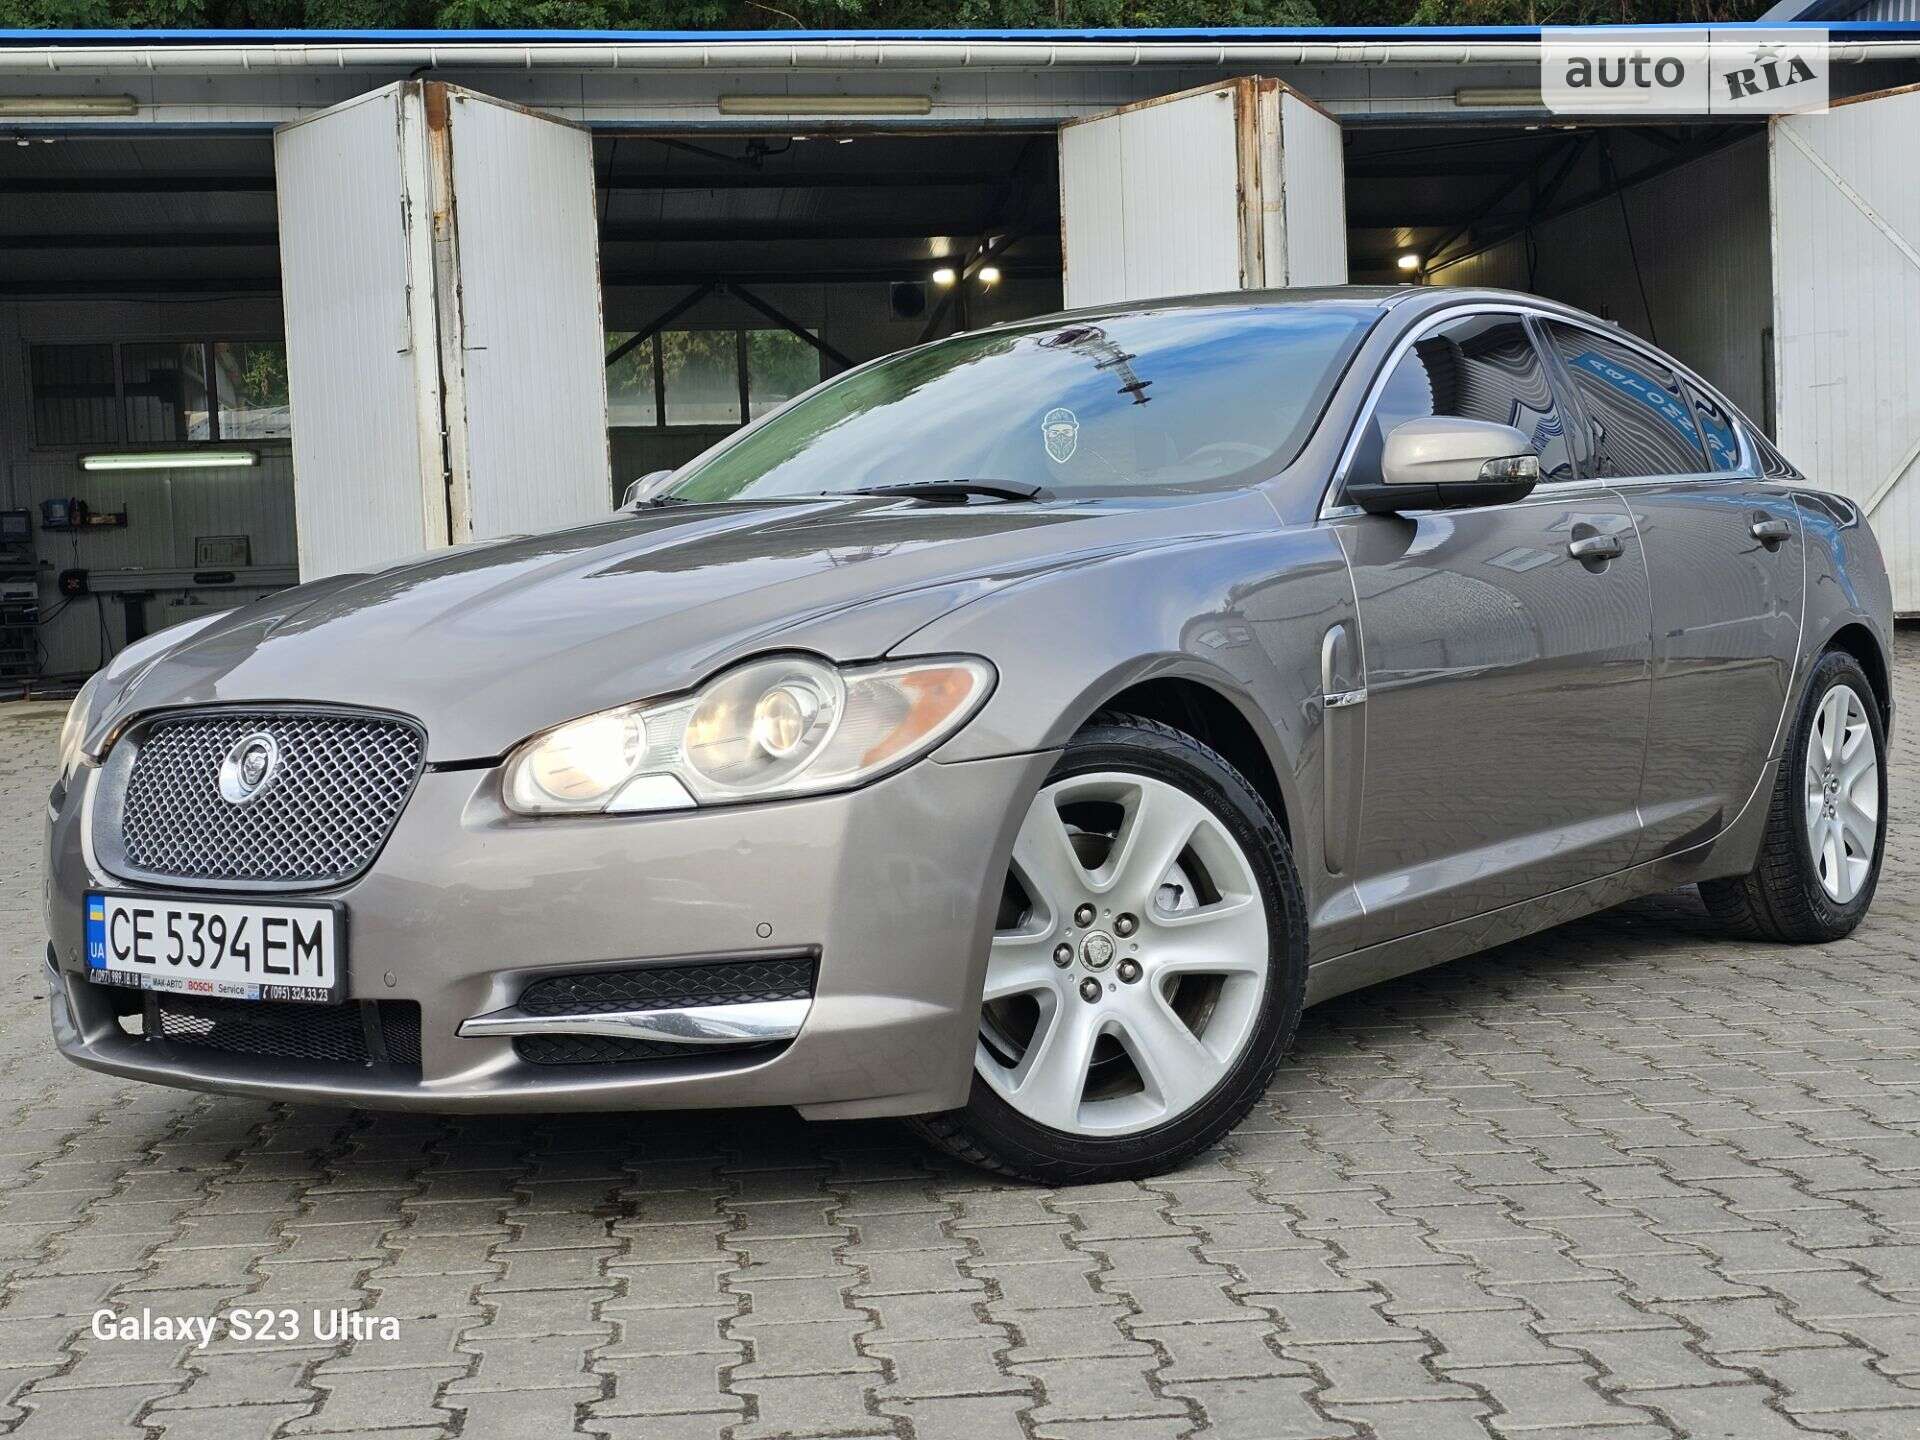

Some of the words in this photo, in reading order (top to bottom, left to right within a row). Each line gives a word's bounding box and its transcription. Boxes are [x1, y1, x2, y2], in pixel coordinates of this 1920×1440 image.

[110, 907, 156, 964] CE
[166, 910, 250, 972] 5394
[262, 917, 323, 977] EM
[90, 943, 105, 958] UA
[188, 980, 214, 993] BOSCH
[218, 983, 245, 995] Service
[270, 985, 290, 1000] (095)
